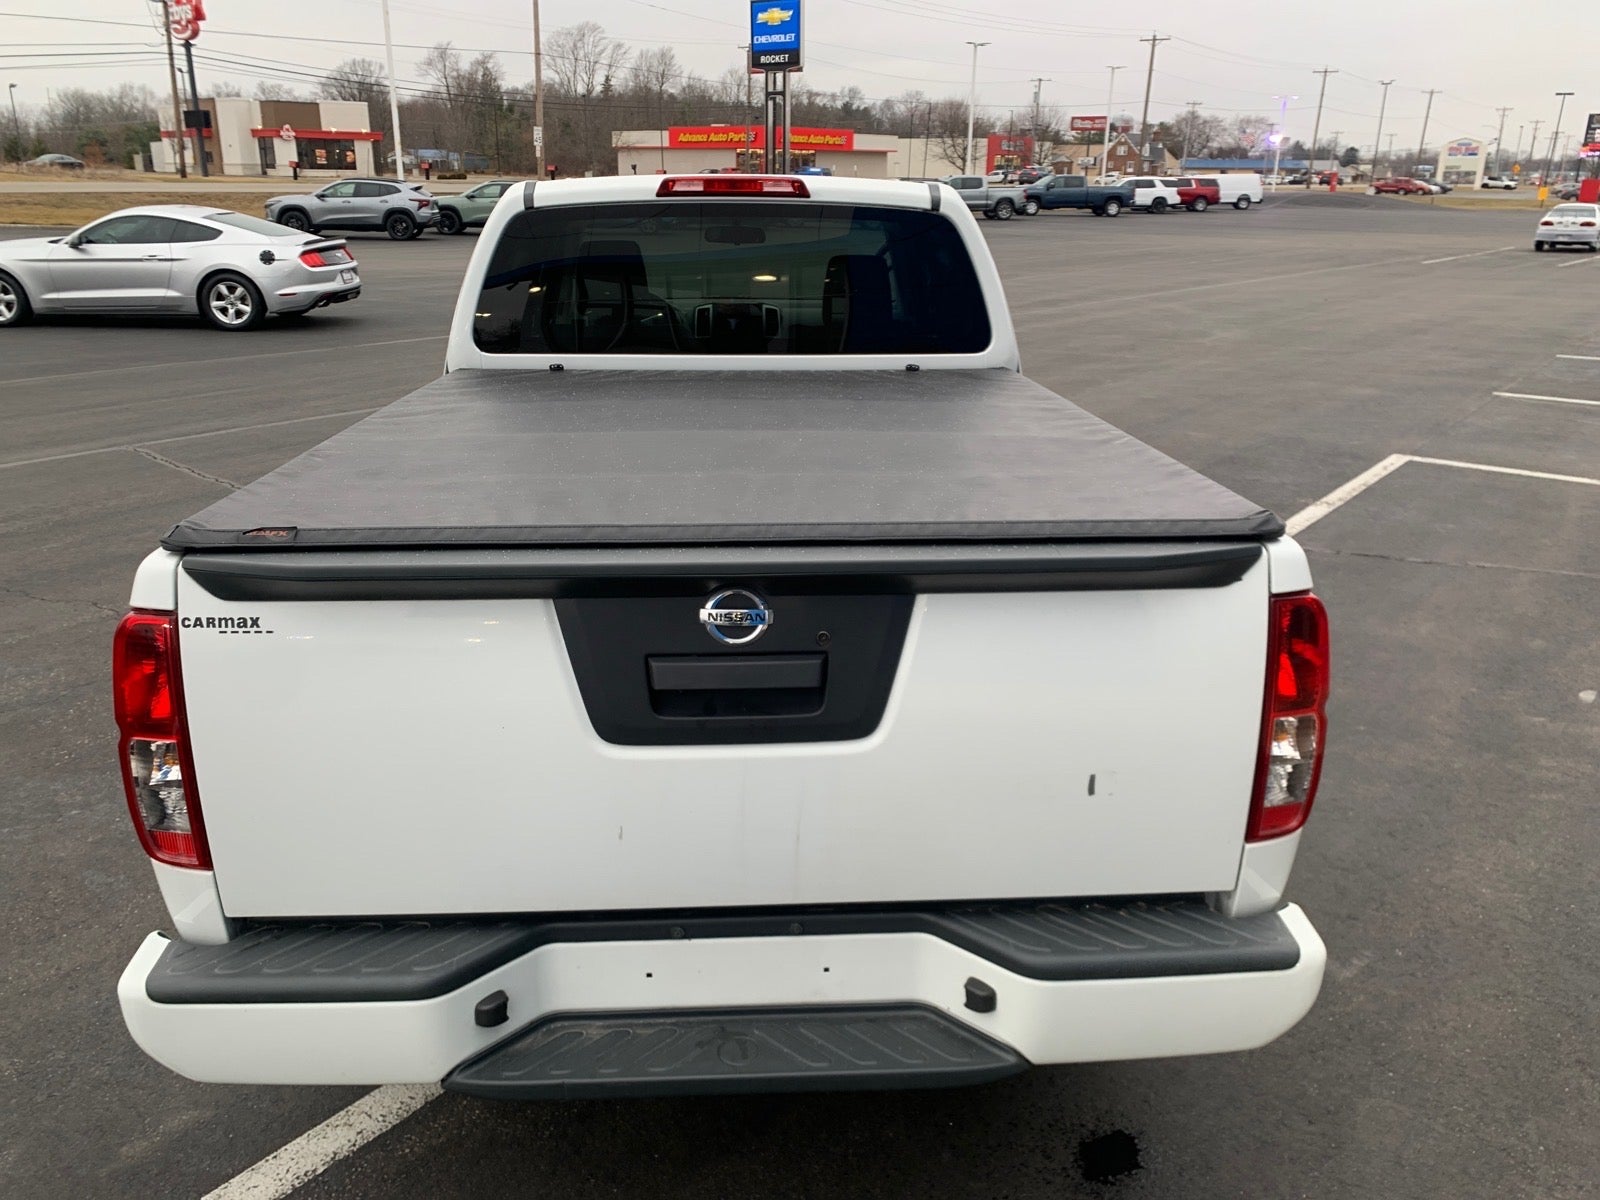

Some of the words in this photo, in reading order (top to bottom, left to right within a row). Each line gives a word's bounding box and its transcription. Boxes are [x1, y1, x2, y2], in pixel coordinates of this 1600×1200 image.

[753, 33, 796, 44] CHEVROLET
[760, 54, 789, 64] ROCKET
[678, 132, 708, 142] Advance
[708, 132, 728, 142] Auto
[808, 134, 825, 144] Auto
[707, 612, 766, 623] NISSAN
